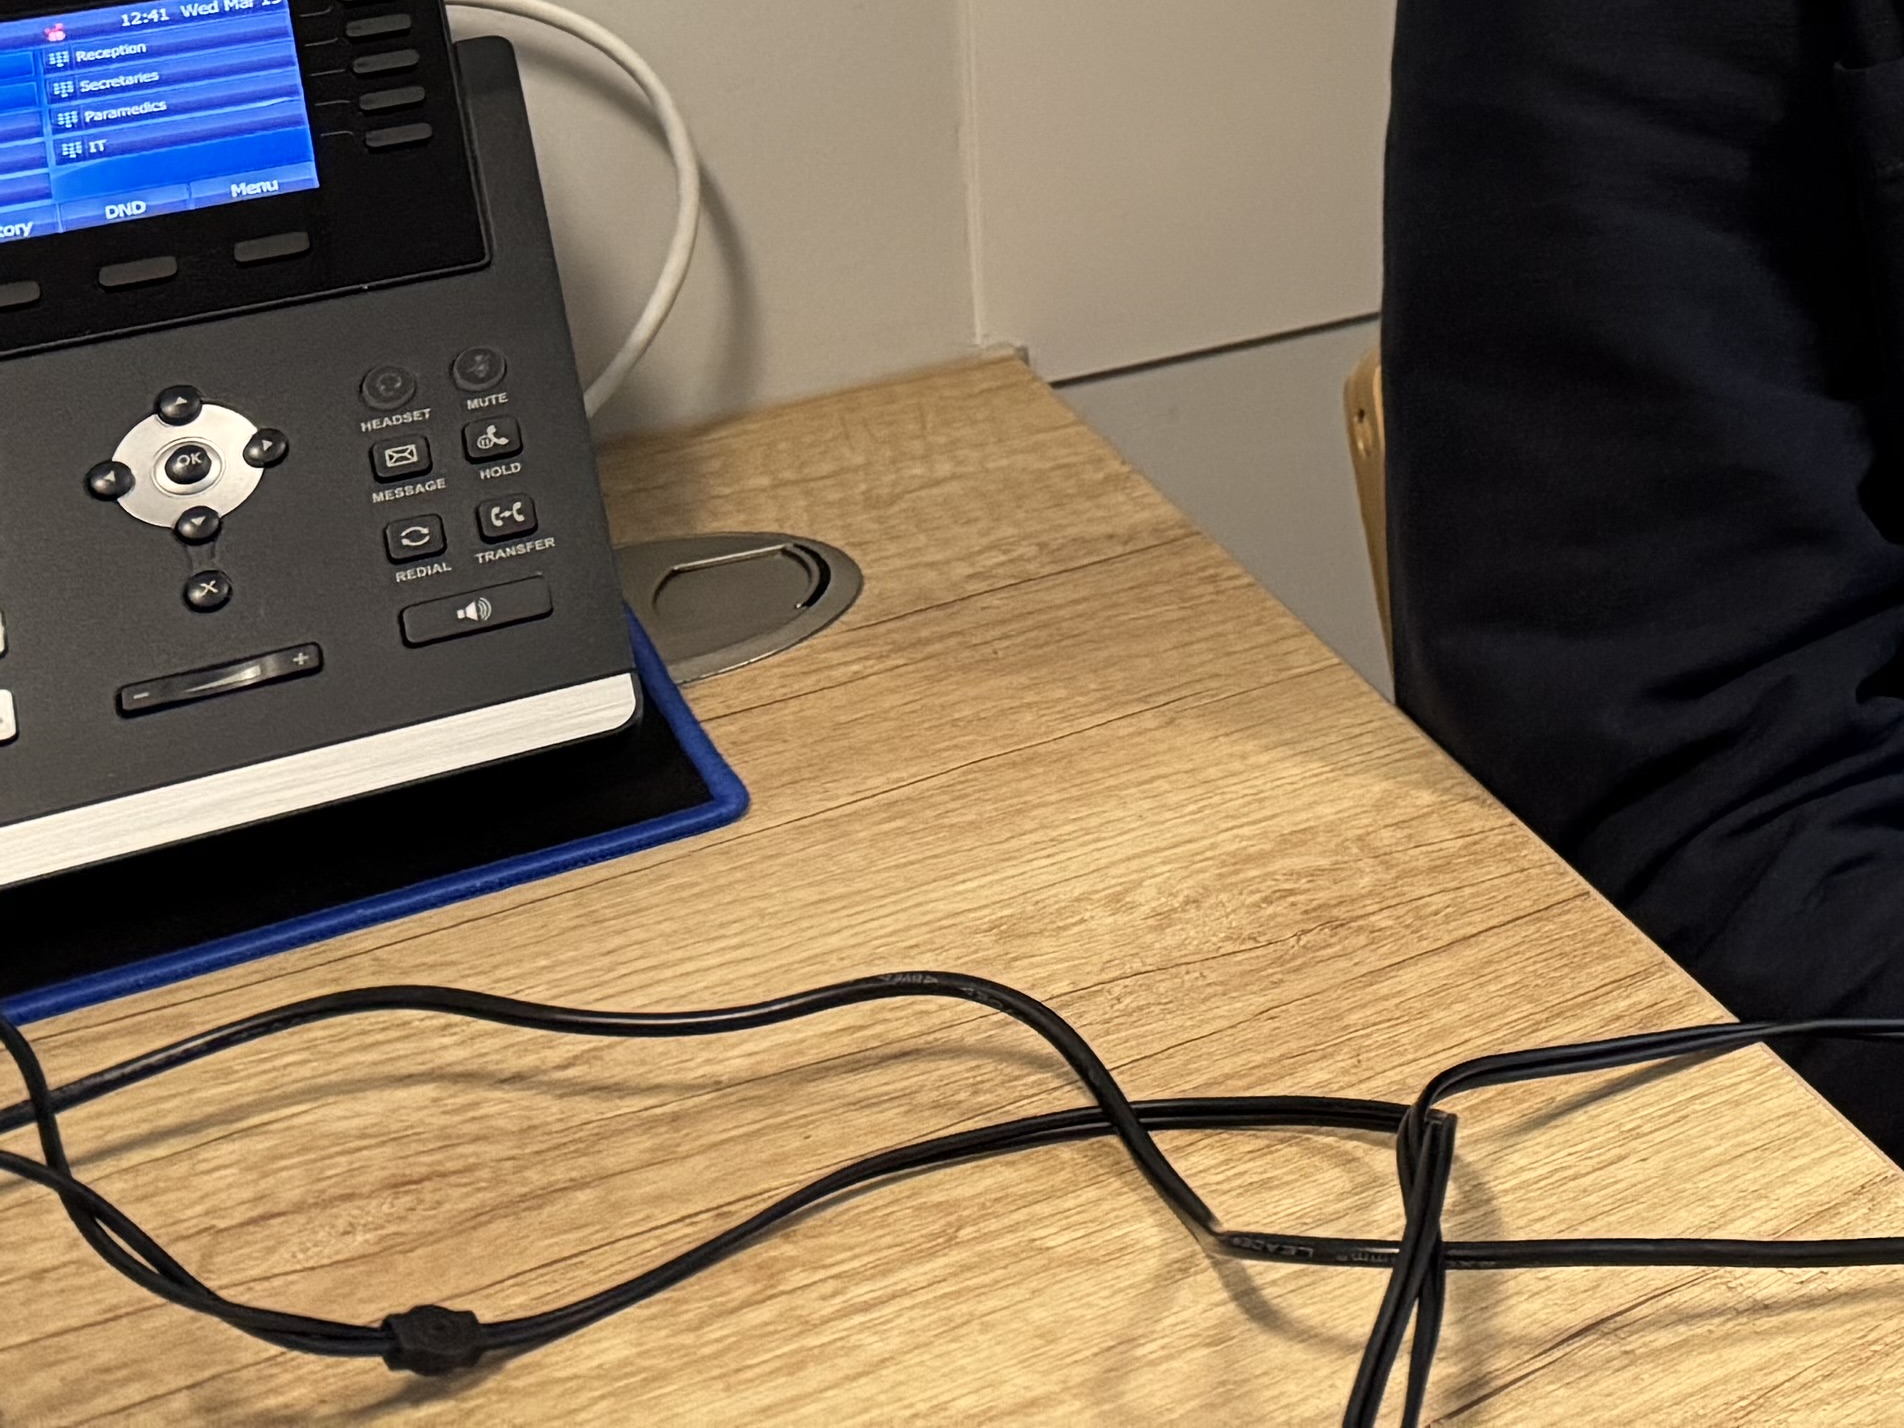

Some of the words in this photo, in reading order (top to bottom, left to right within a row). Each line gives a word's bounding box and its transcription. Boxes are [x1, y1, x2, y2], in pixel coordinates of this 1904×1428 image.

[120, 7, 169, 26] 12:41
[179, 0, 219, 17] Wed
[75, 43, 146, 62] Reception
[79, 71, 159, 92] Secretaries
[84, 100, 167, 122] Paramedics
[88, 139, 106, 152] IT
[230, 179, 278, 197] Menu
[105, 200, 146, 219] DND
[466, 392, 508, 409] MUTE
[360, 408, 430, 431] HEADSET
[177, 452, 202, 466] OK
[479, 462, 521, 479] HOLD
[373, 478, 447, 502] MESSAGE
[474, 537, 555, 563] TRANSFER
[395, 562, 452, 582] REDIAL
